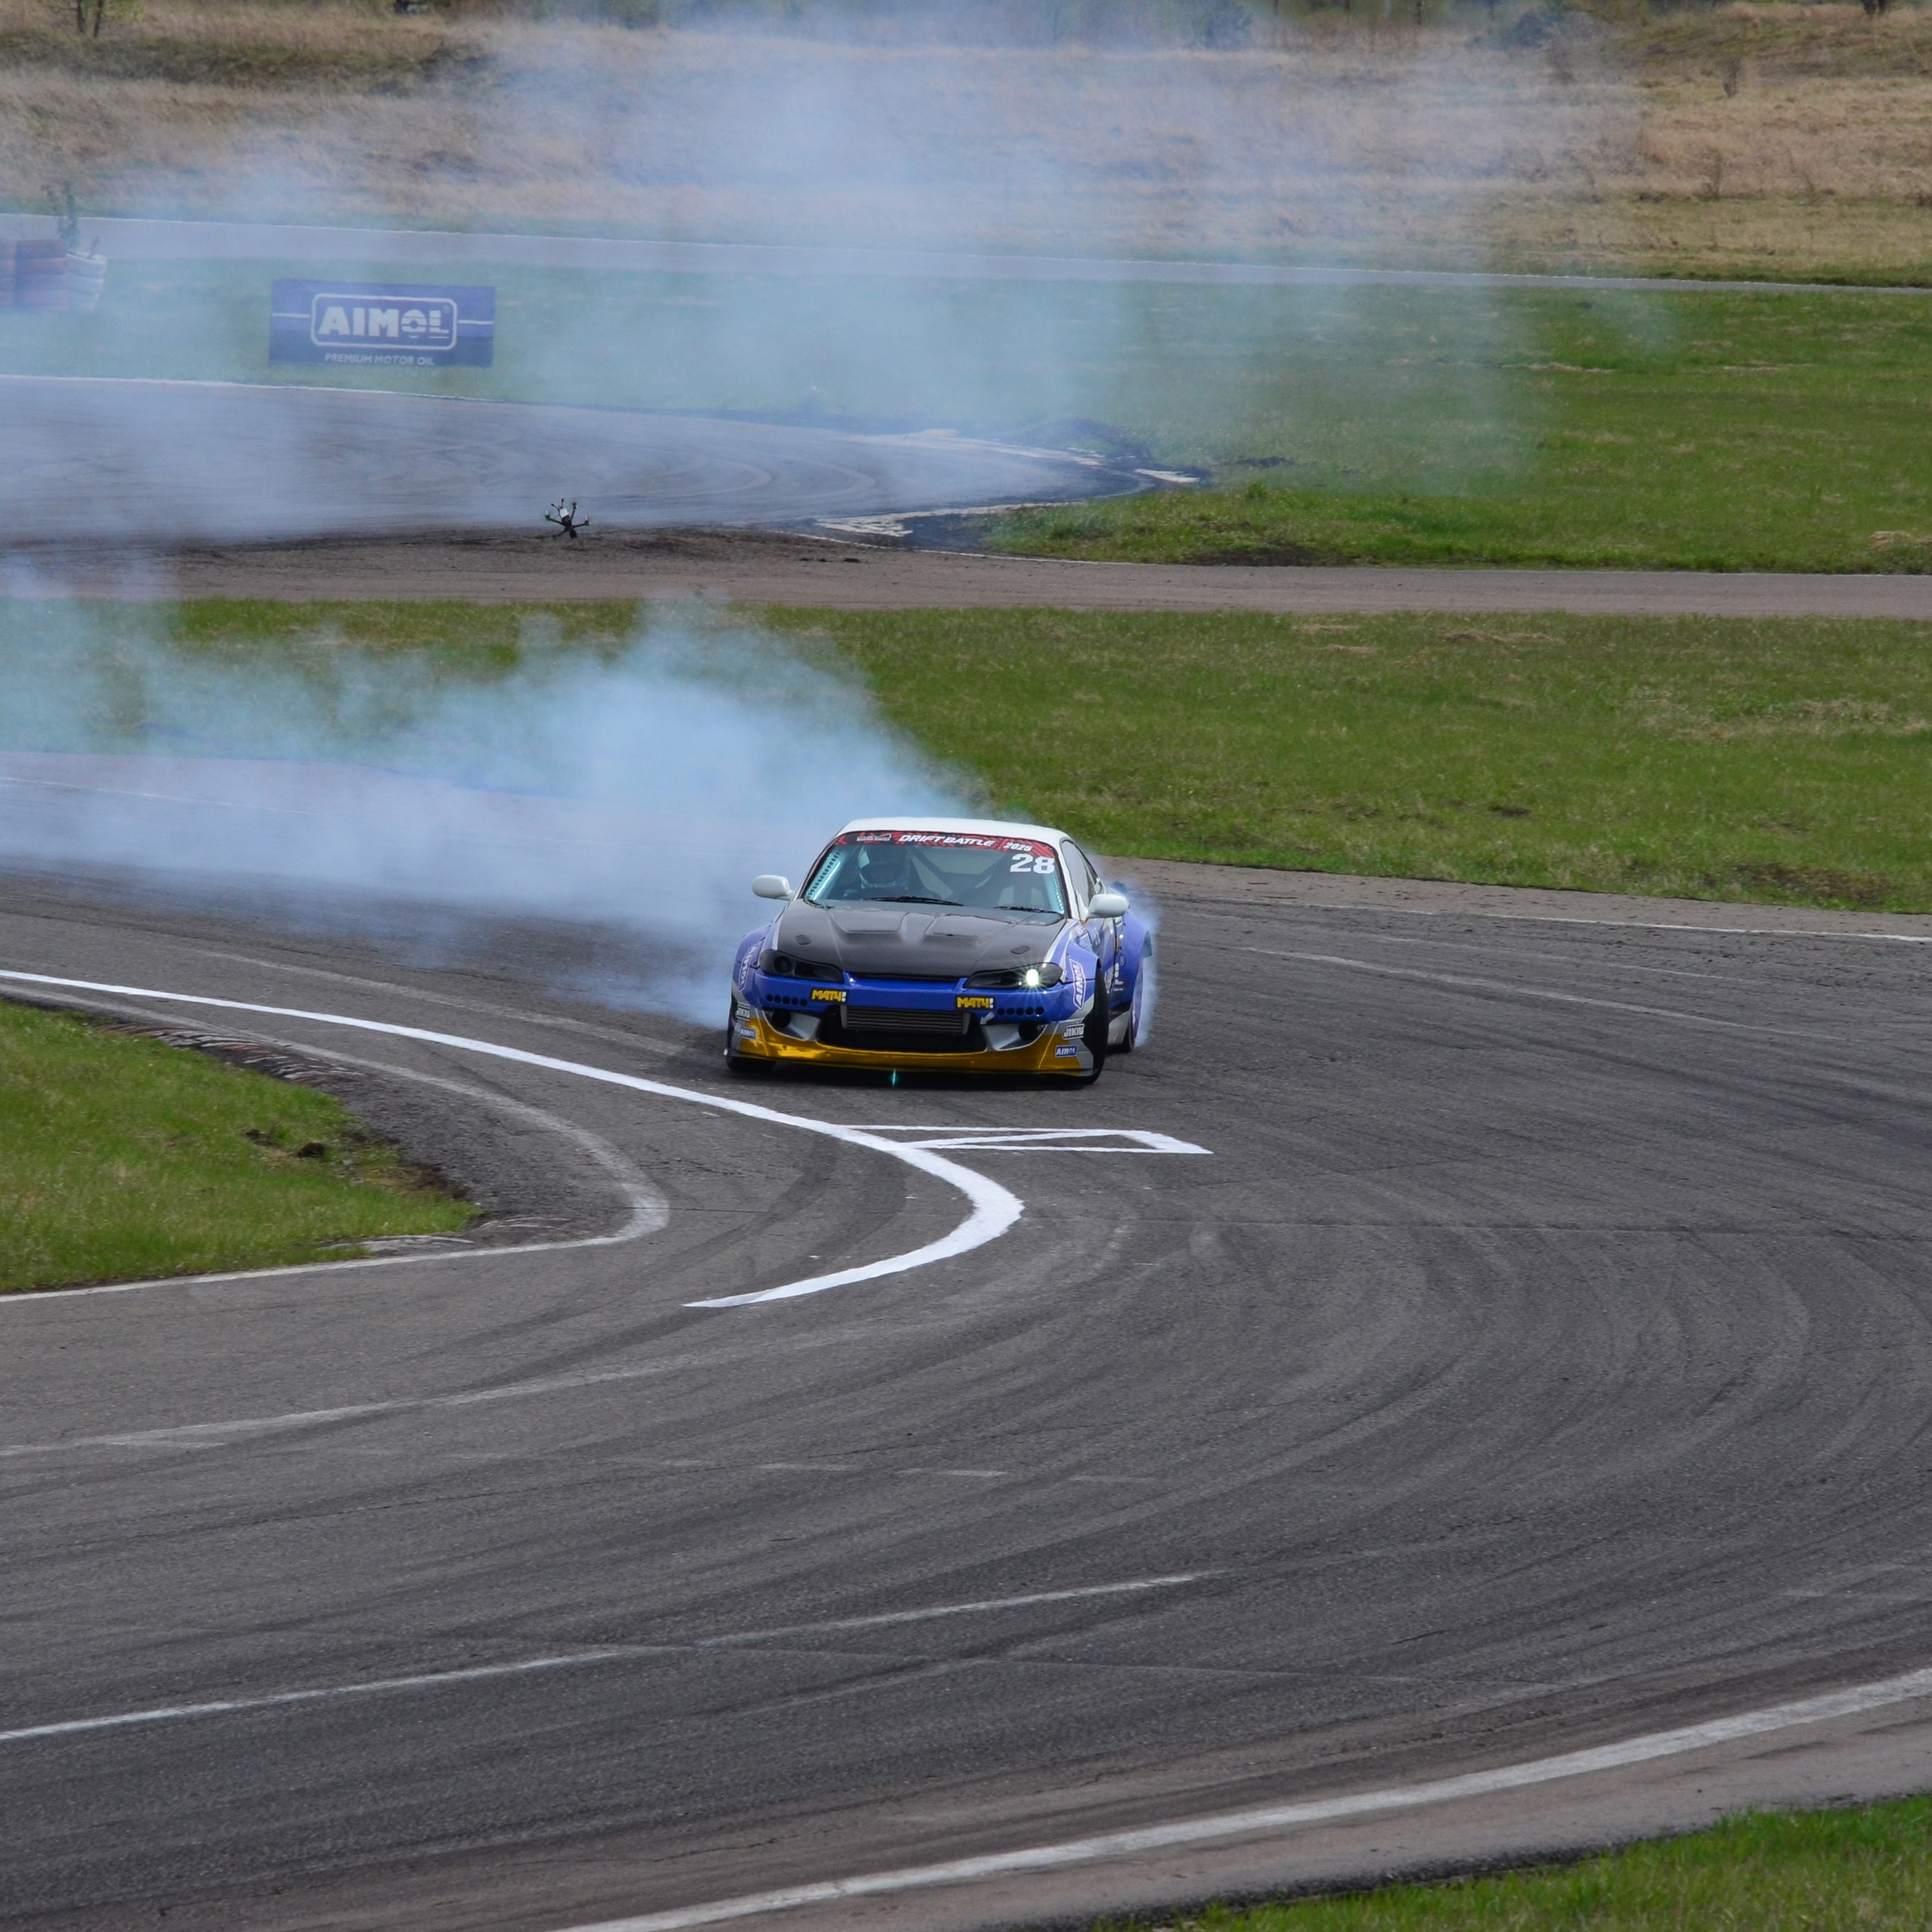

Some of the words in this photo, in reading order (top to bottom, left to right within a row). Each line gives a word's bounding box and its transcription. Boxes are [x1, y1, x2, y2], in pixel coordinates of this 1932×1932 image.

[318, 306, 449, 339] AIMOL
[325, 353, 373, 363] PREMIUM
[374, 355, 414, 365] MOTOR
[417, 356, 435, 366] OIL
[898, 835, 945, 843] DRIFT
[943, 836, 995, 846] BATTLE
[1010, 853, 1055, 874] 28
[1072, 962, 1084, 1006] AIMOL
